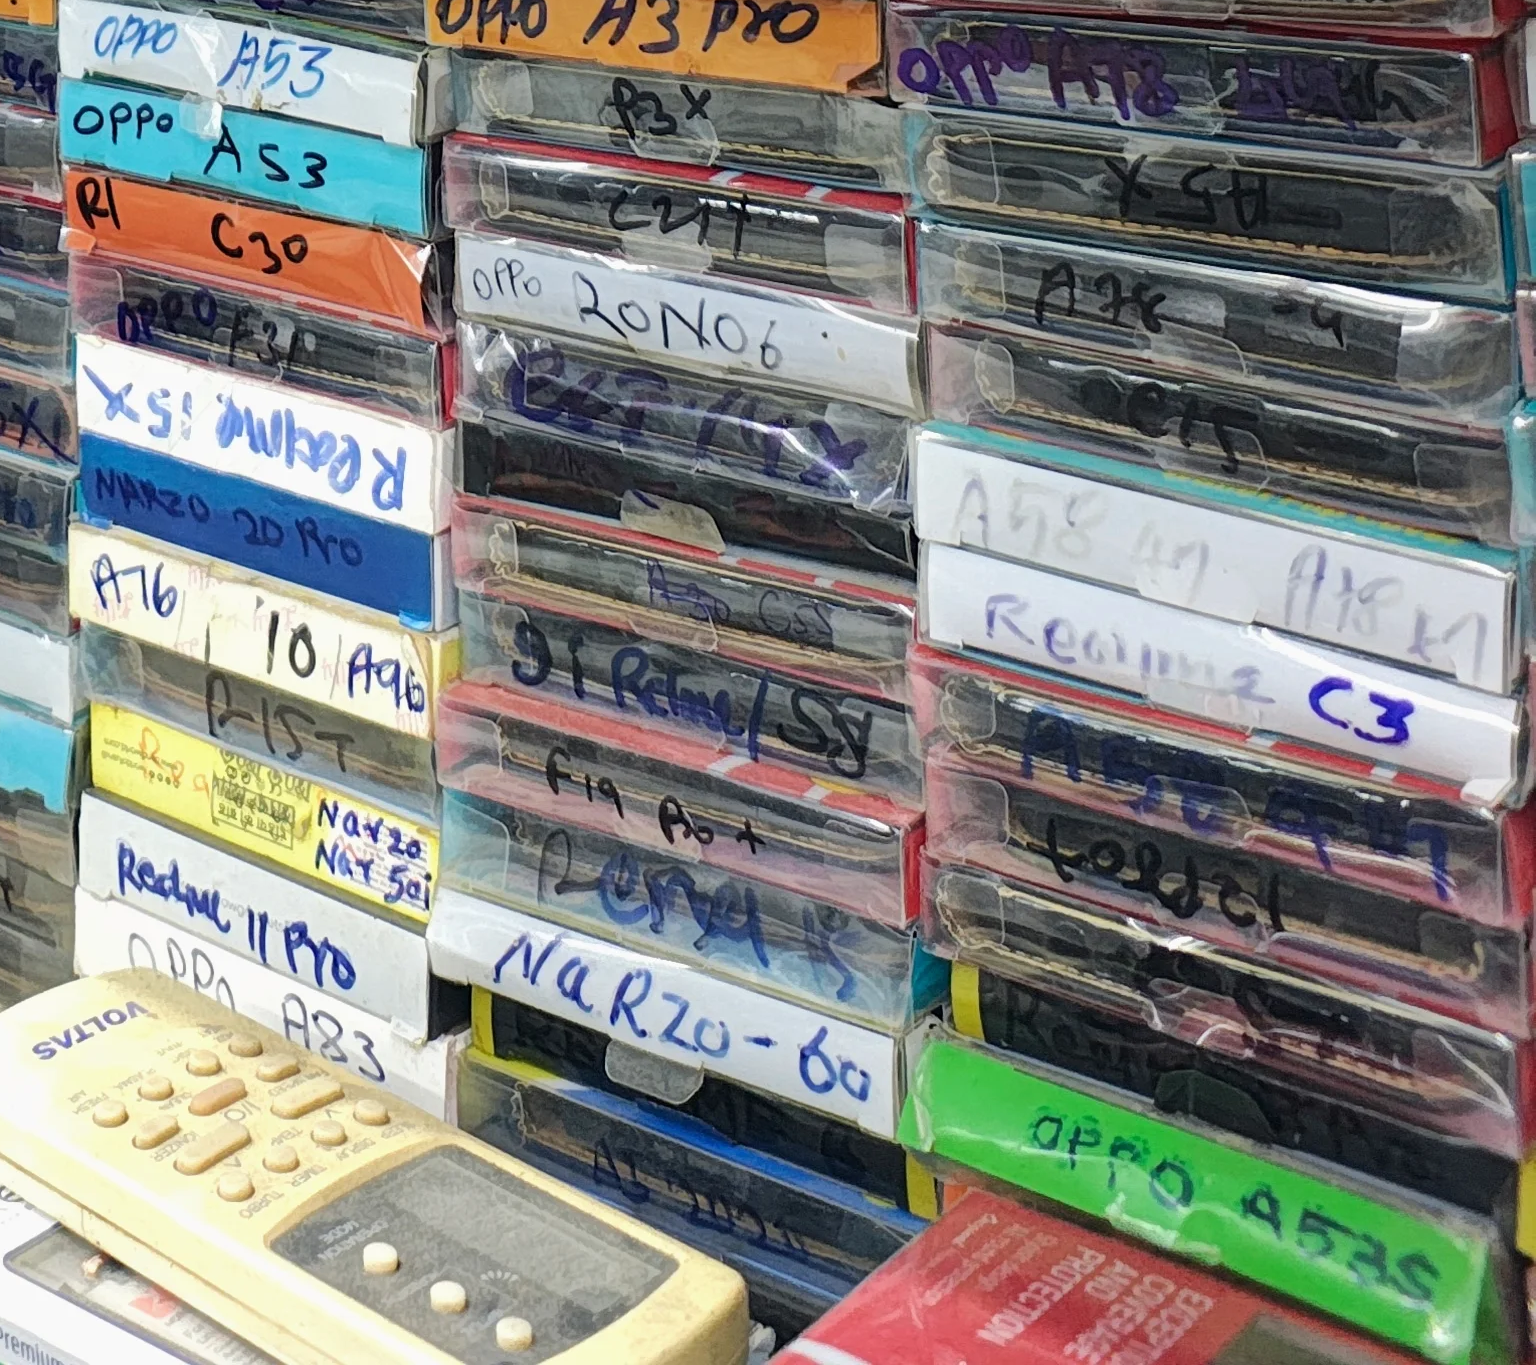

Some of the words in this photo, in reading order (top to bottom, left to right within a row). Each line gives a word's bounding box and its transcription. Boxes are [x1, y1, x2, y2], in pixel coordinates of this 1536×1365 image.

[94, 14, 178, 65] OPPO
[217, 30, 333, 99] A53
[203, 124, 328, 188] A53
[210, 212, 309, 275] C30
[266, 609, 317, 679] 10
[1308, 676, 1415, 746] C3
[31, 1000, 150, 1061] VOLTAS
[280, 992, 385, 1082] A83
